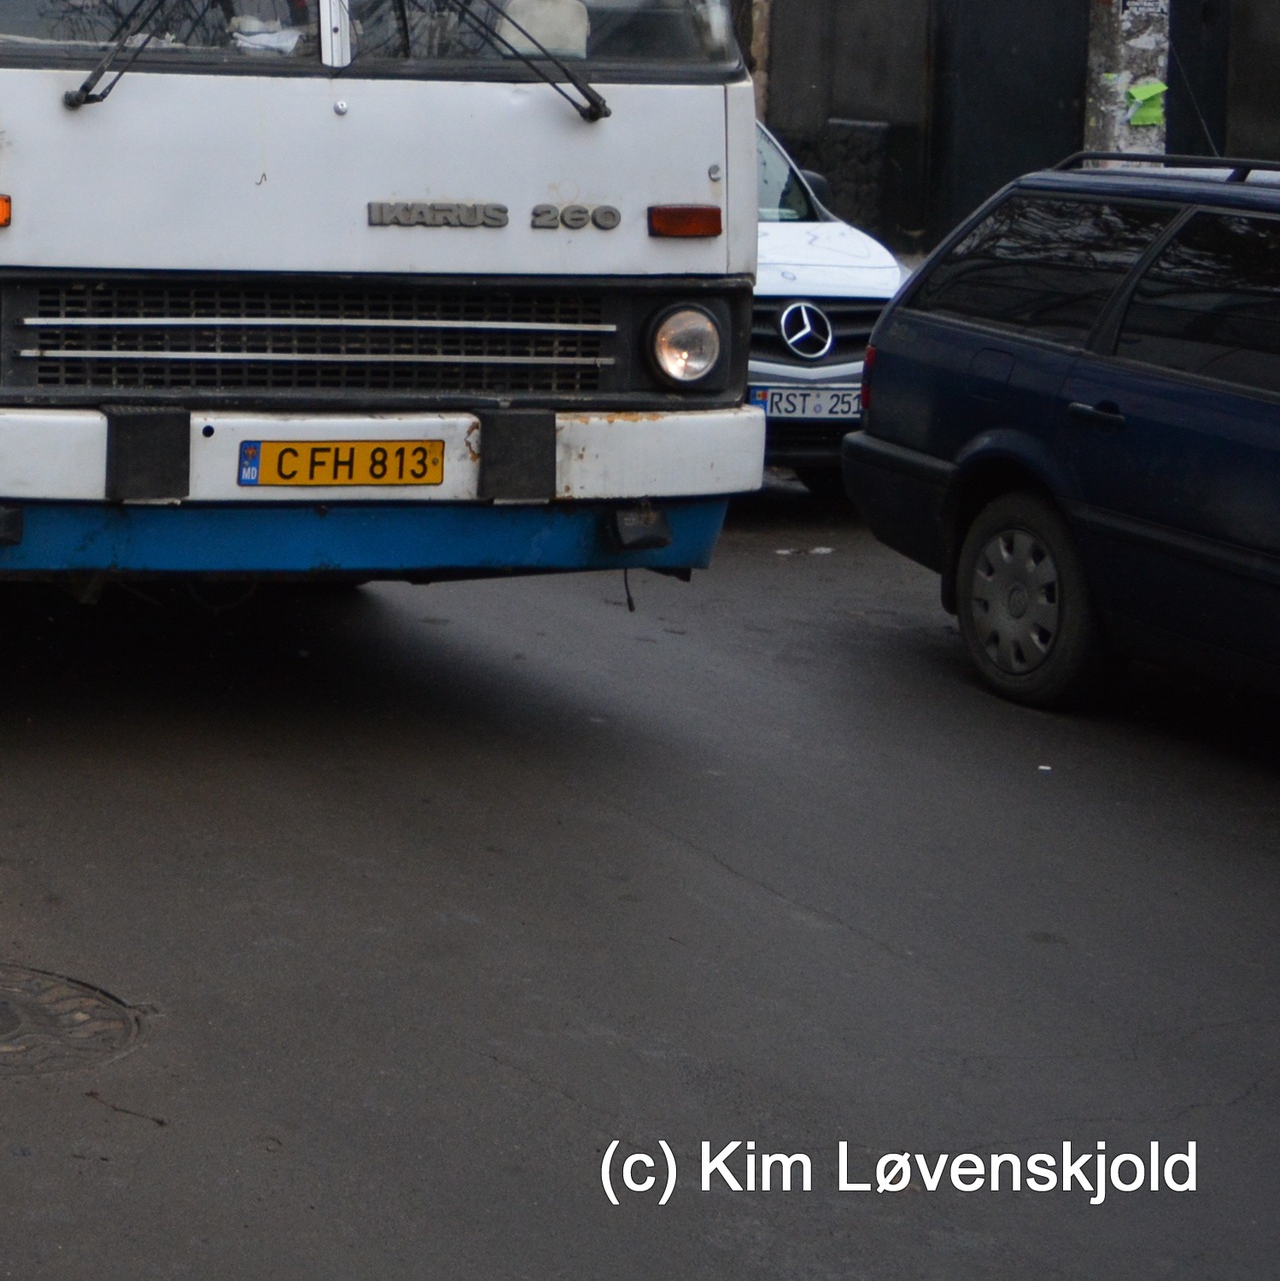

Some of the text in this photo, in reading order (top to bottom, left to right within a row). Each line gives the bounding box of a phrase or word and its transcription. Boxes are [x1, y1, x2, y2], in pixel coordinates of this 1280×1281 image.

[367, 201, 622, 231] IKARUS 260
[769, 391, 861, 416] RST 251
[241, 467, 258, 481] MD
[368, 446, 429, 480] 813
